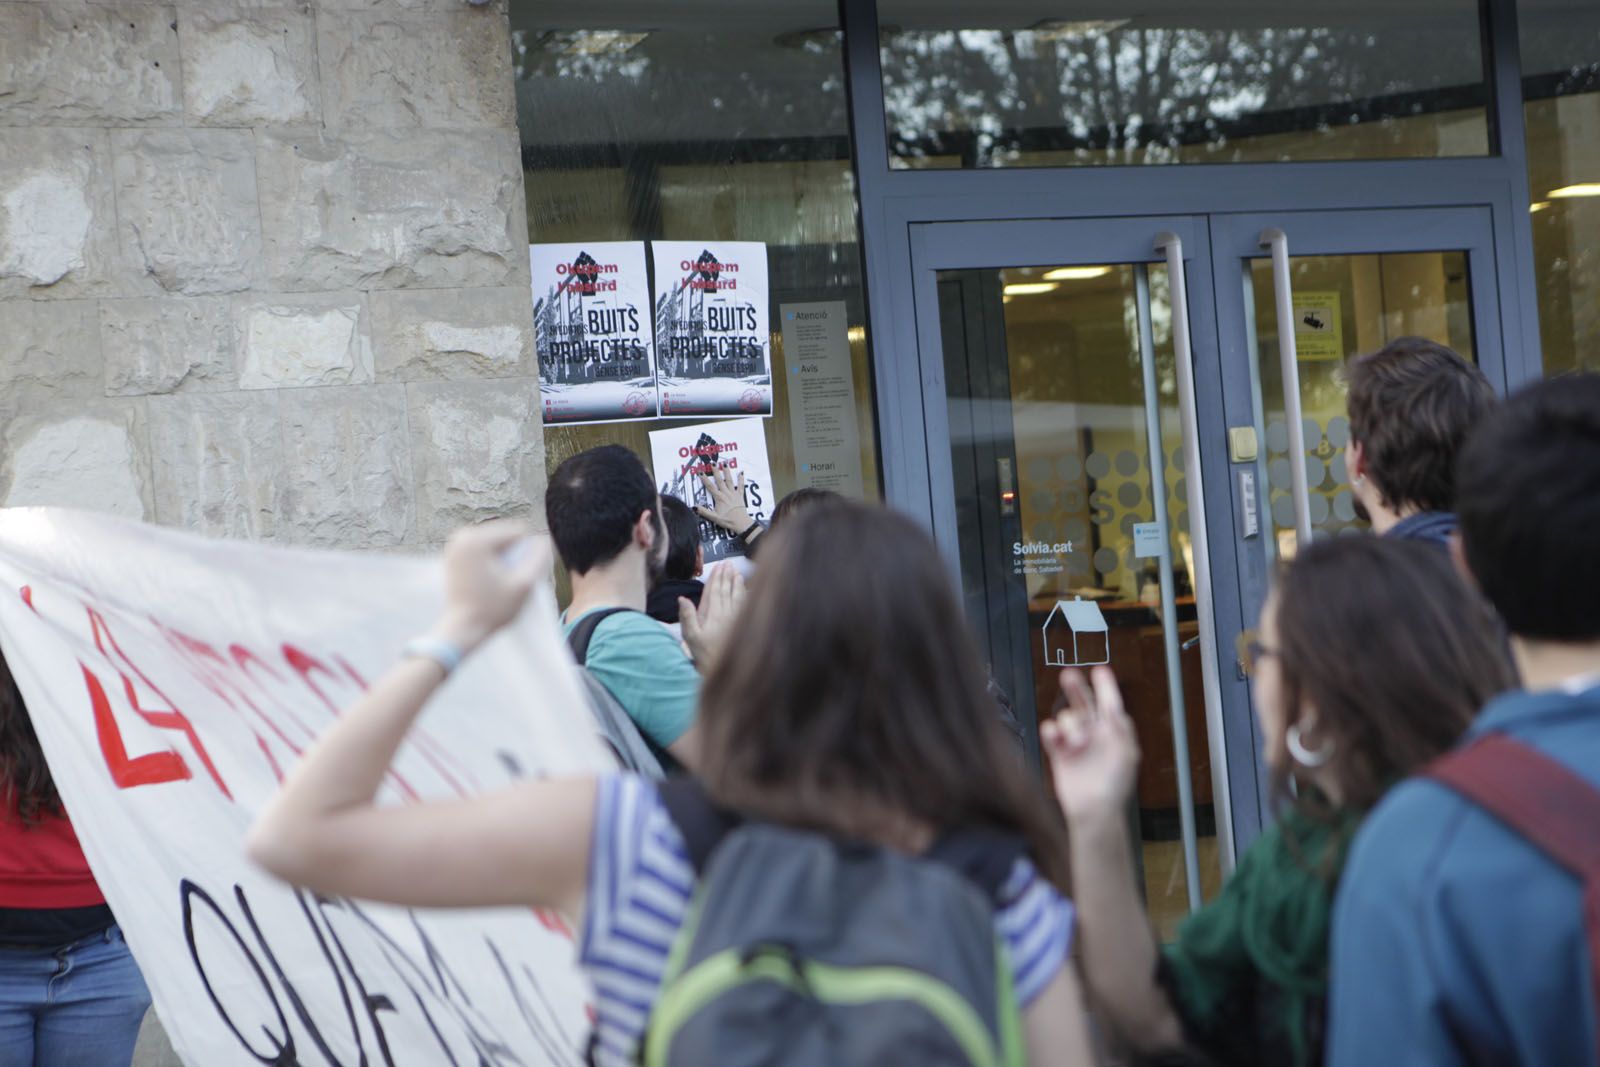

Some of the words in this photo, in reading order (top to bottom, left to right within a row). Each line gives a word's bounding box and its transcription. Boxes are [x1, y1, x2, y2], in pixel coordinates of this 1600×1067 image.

[556, 263, 618, 276] Okupem
[680, 260, 739, 273] Okupem
[588, 308, 640, 334] BUITS
[708, 306, 757, 332] BUITS
[549, 338, 642, 364] PROJECTES
[670, 336, 758, 360] PROJECTES
[679, 441, 738, 459] Okupem
[1013, 541, 1073, 555] Solvia.cat
